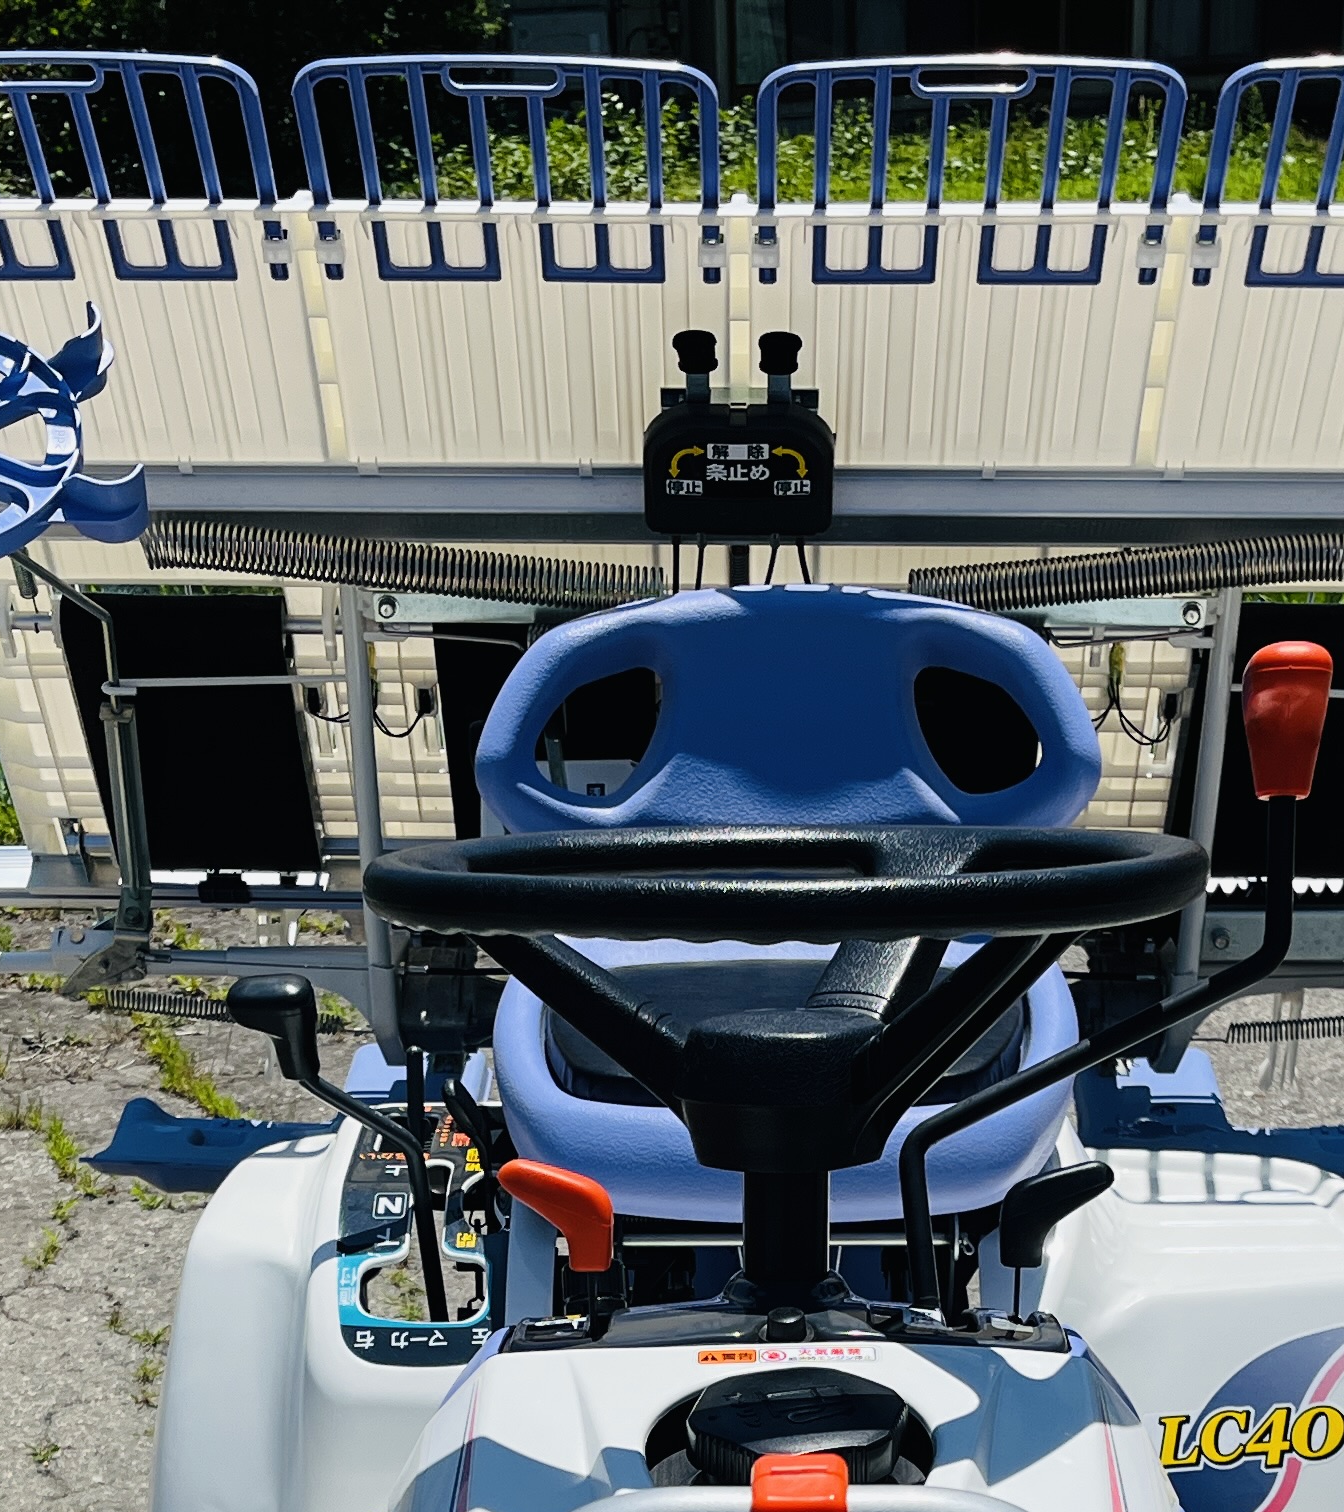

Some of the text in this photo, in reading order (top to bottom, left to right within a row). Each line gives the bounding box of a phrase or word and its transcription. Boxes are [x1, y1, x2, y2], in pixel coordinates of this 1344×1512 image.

[706, 464, 770, 481] 条止め
[667, 480, 702, 495] 停止
[775, 480, 810, 495] 停止
[376, 1196, 403, 1215] N
[354, 1328, 492, 1349] 左 マーカ 右
